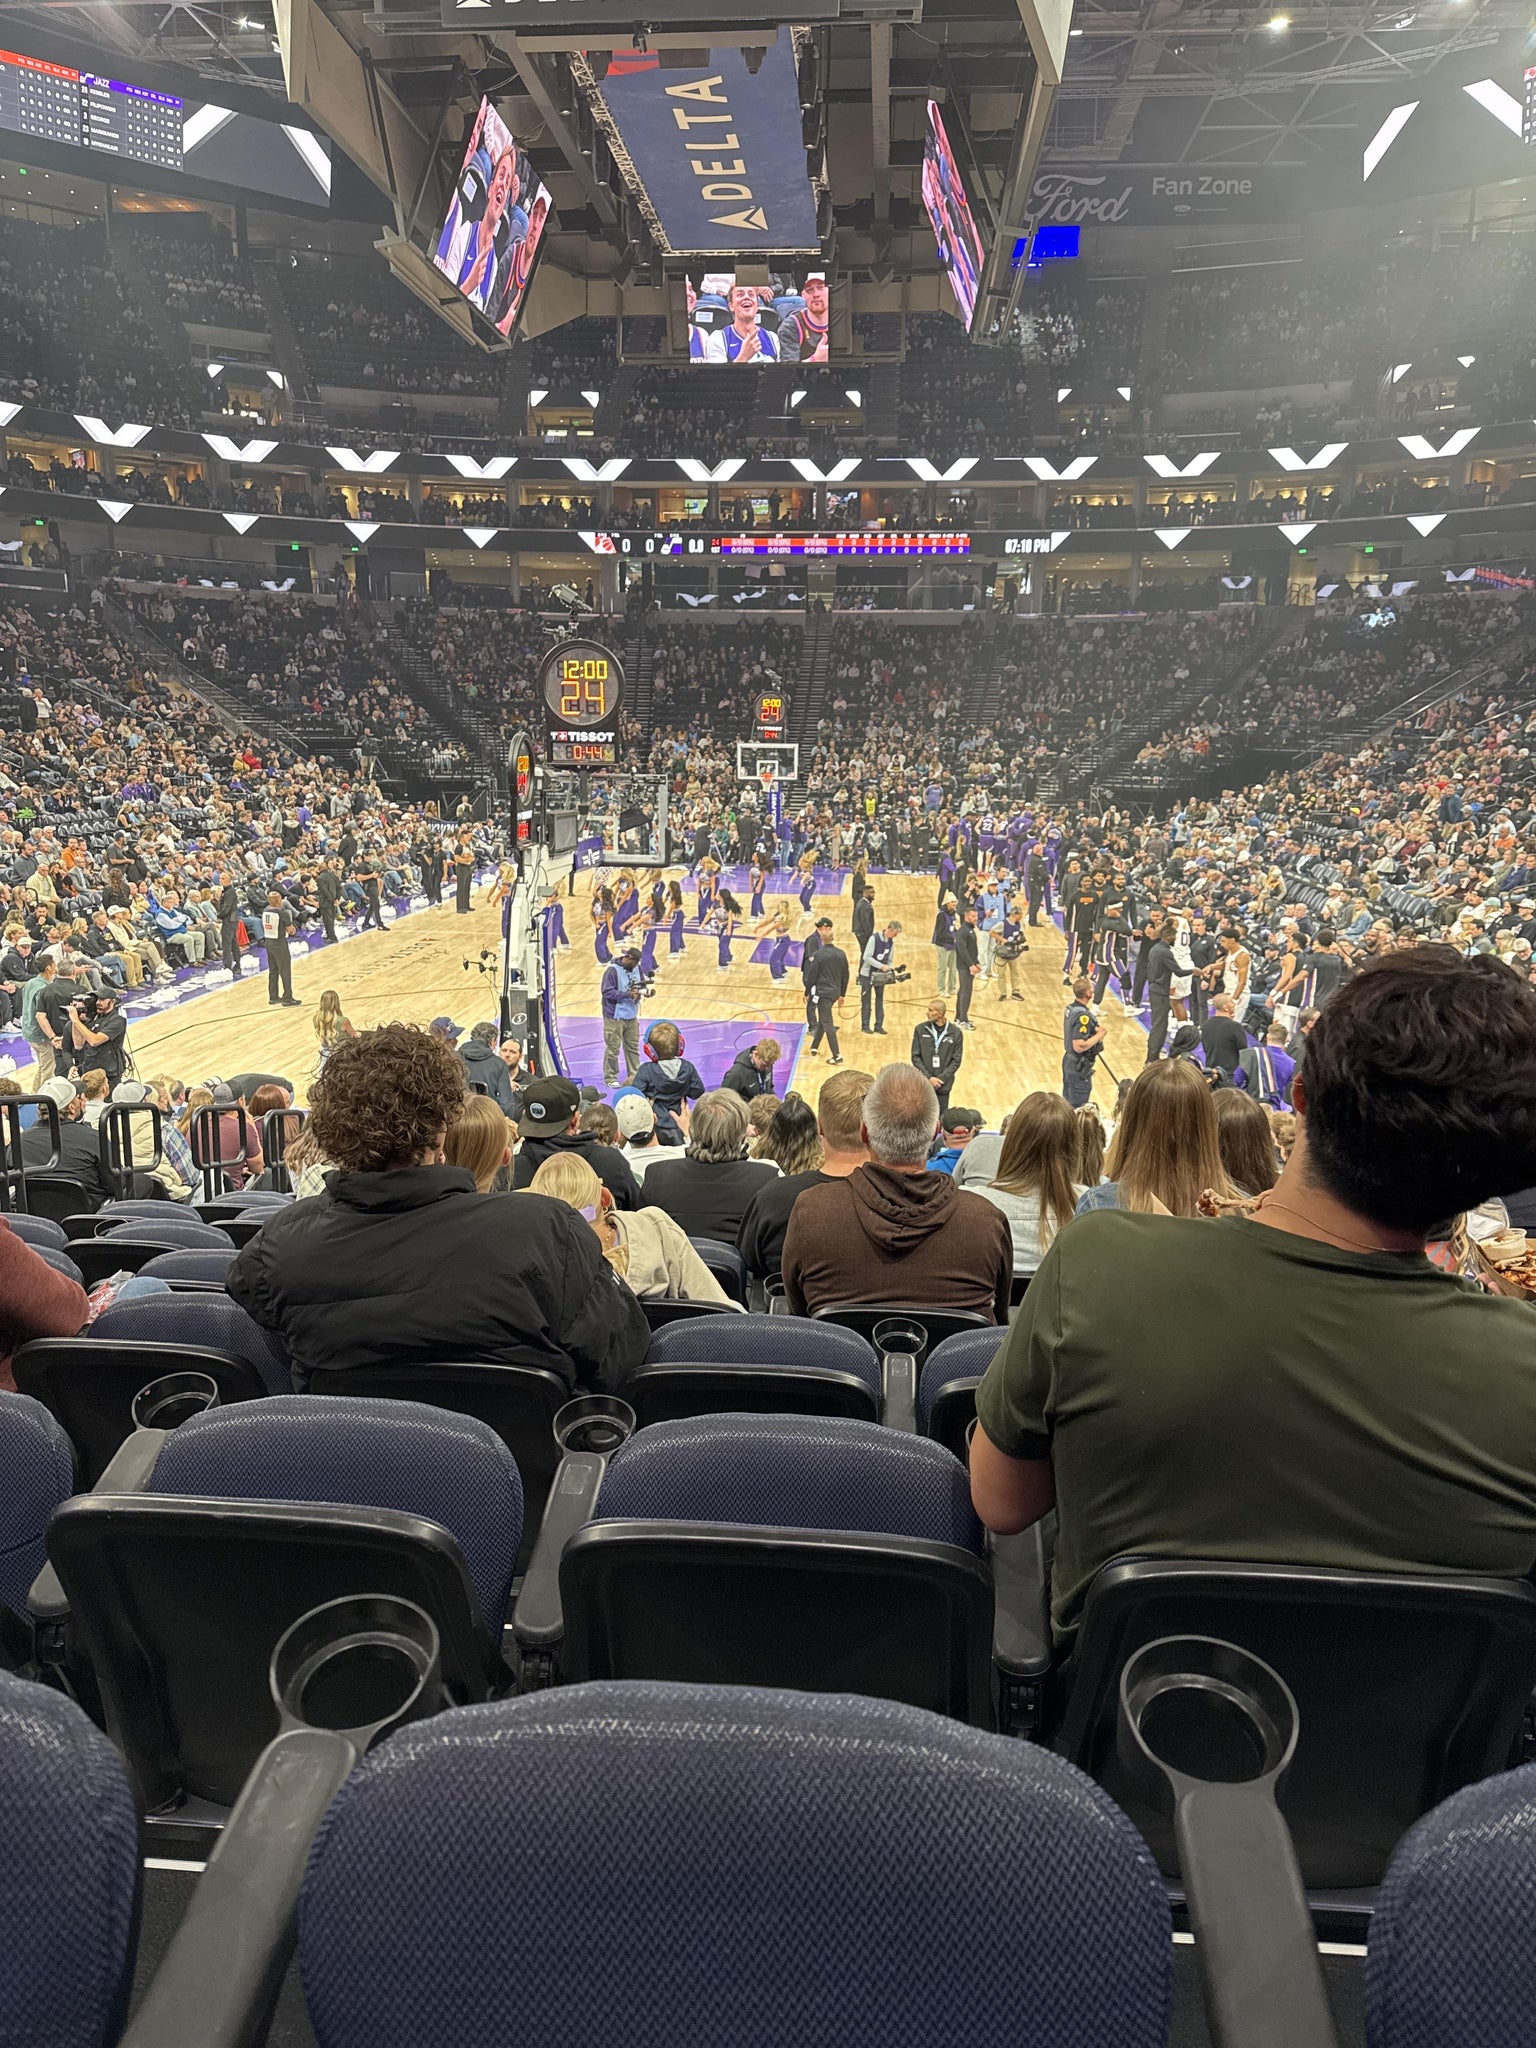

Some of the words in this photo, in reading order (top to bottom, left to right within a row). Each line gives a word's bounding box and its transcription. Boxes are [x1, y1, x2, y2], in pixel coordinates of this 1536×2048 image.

[93, 77, 110, 88] JAZZ
[82, 98, 88, 107] 22
[664, 76, 752, 200] DELTA
[1152, 176, 1193, 196] Fan
[1198, 176, 1253, 196] Zone
[1024, 174, 1133, 222] Ford
[622, 538, 630, 553] 0
[646, 538, 654, 553] 0
[1033, 539, 1050, 553] PM
[564, 660, 608, 679] 12:00
[560, 681, 605, 716] 24
[761, 707, 780, 721] 24
[573, 745, 602, 759] 0:44
[982, 822, 993, 831] 22
